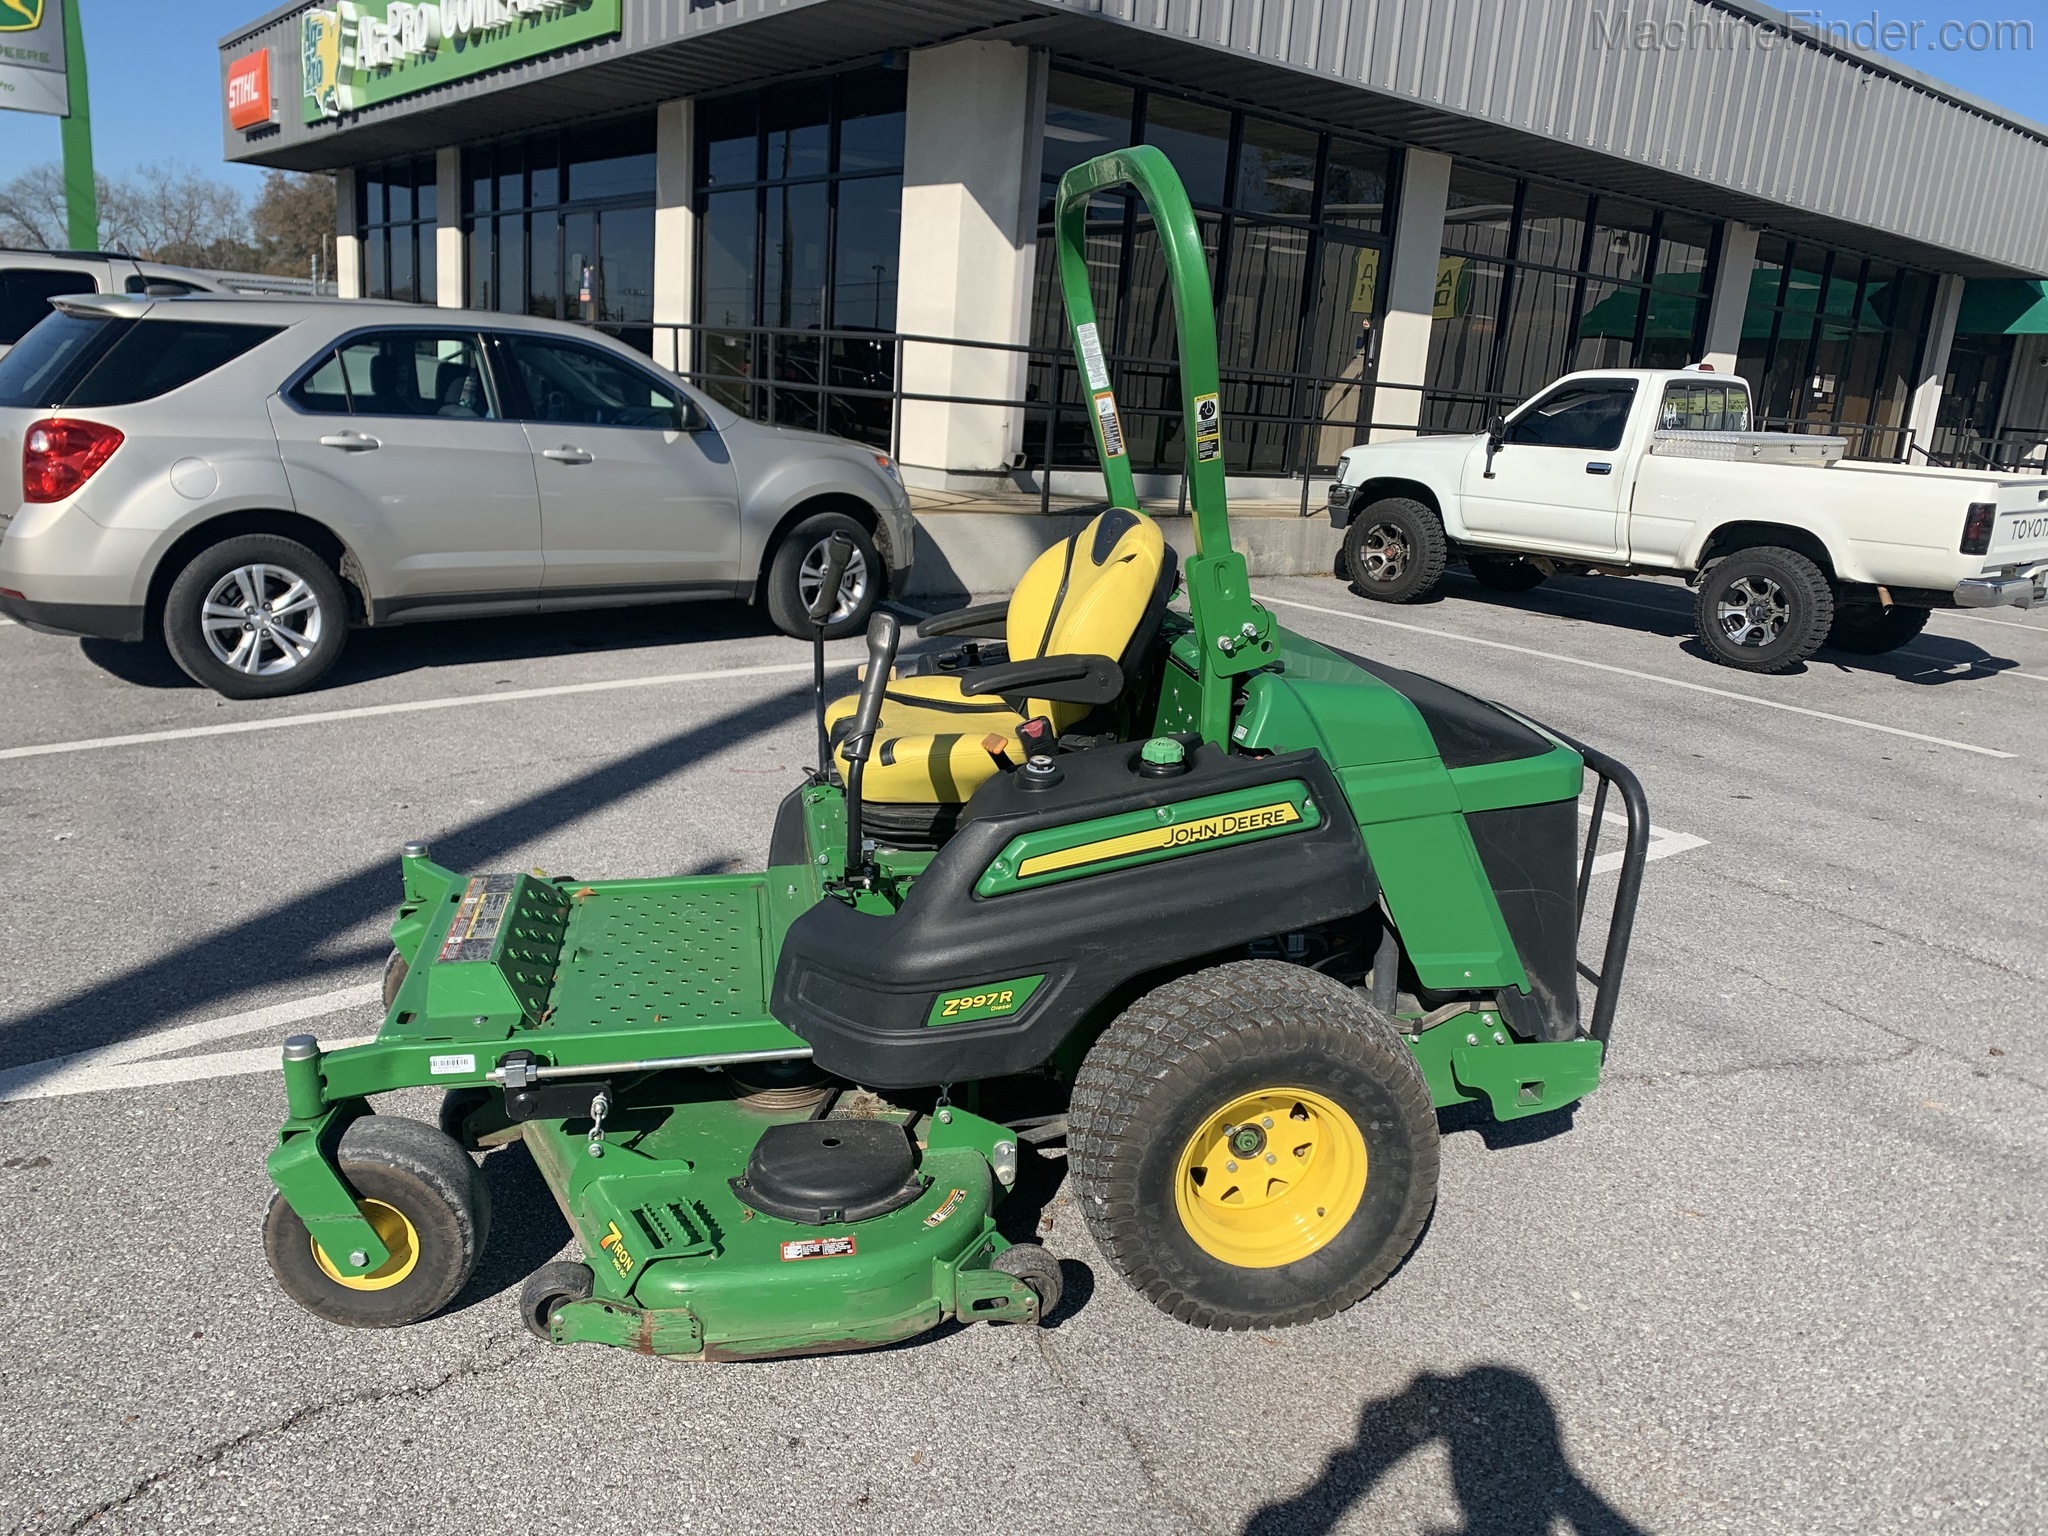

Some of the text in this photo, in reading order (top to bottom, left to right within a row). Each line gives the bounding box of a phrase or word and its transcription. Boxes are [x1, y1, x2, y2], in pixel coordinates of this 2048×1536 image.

[0, 44, 50, 63] EERE
[229, 70, 259, 109] STIHL
[2012, 517, 2048, 540] TOYOT
[1162, 809, 1286, 848] JOHN DEERE
[942, 990, 1013, 1016] Z997R
[990, 1003, 1012, 1012] Diesel
[600, 1220, 634, 1272] 7 IRON
